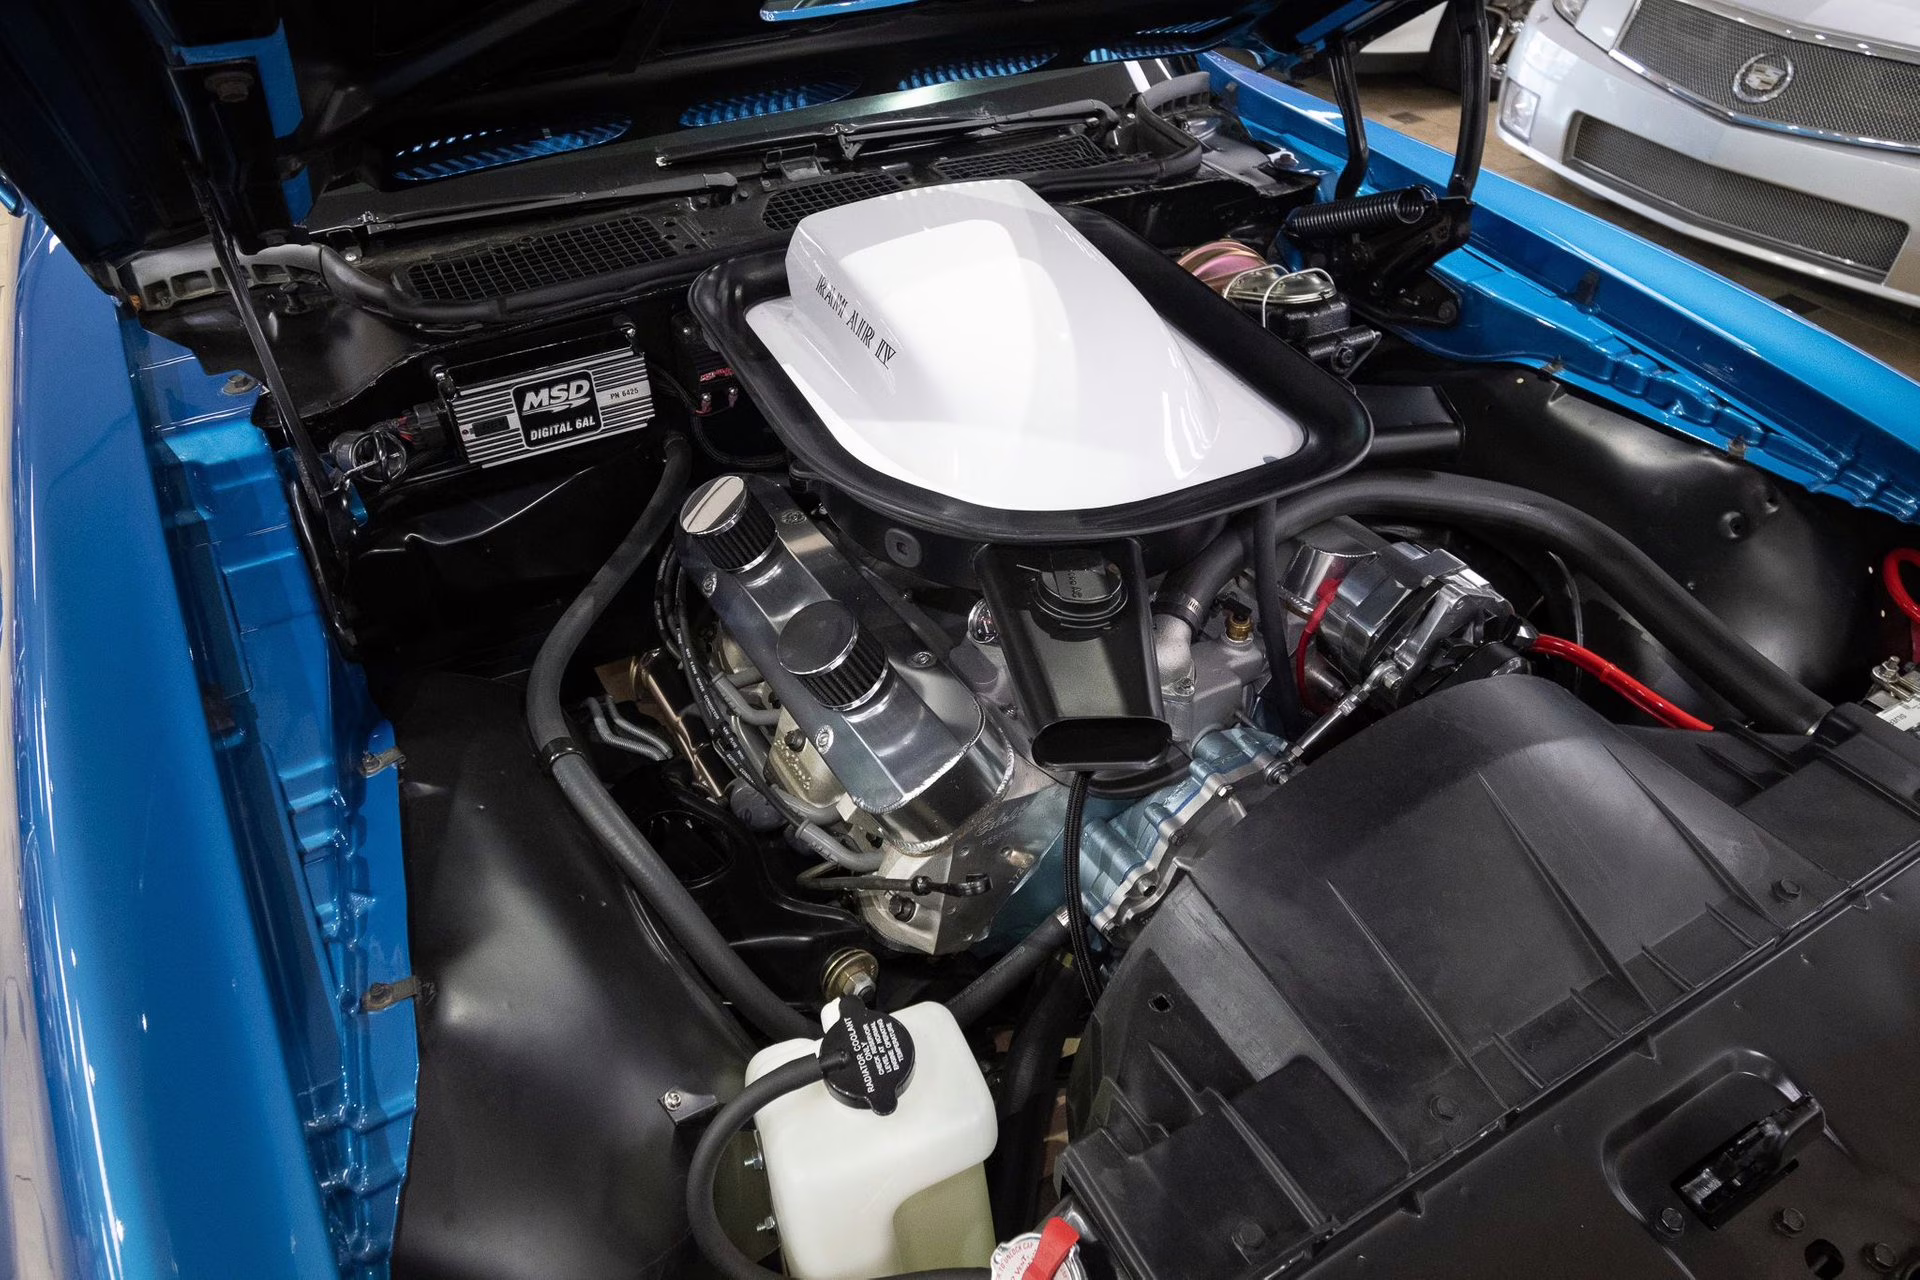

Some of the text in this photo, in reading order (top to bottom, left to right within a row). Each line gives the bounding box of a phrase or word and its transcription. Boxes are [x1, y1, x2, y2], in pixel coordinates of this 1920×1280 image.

[815, 274, 896, 370] RAM AIR IV
[521, 379, 591, 412] MSD
[610, 387, 639, 400] PN 6425
[530, 415, 596, 441] DIGITAL 6AL
[844, 1017, 875, 1092] RADIATOR COOLANT
[860, 1040, 872, 1060] ONLY
[862, 1022, 884, 1075] CHECK RESERVOIR
[869, 1020, 892, 1073] LEVEL AT NORMAL
[876, 1018, 899, 1070] ENGINE OPERATING
[885, 1021, 904, 1062] TEMPERATURE
